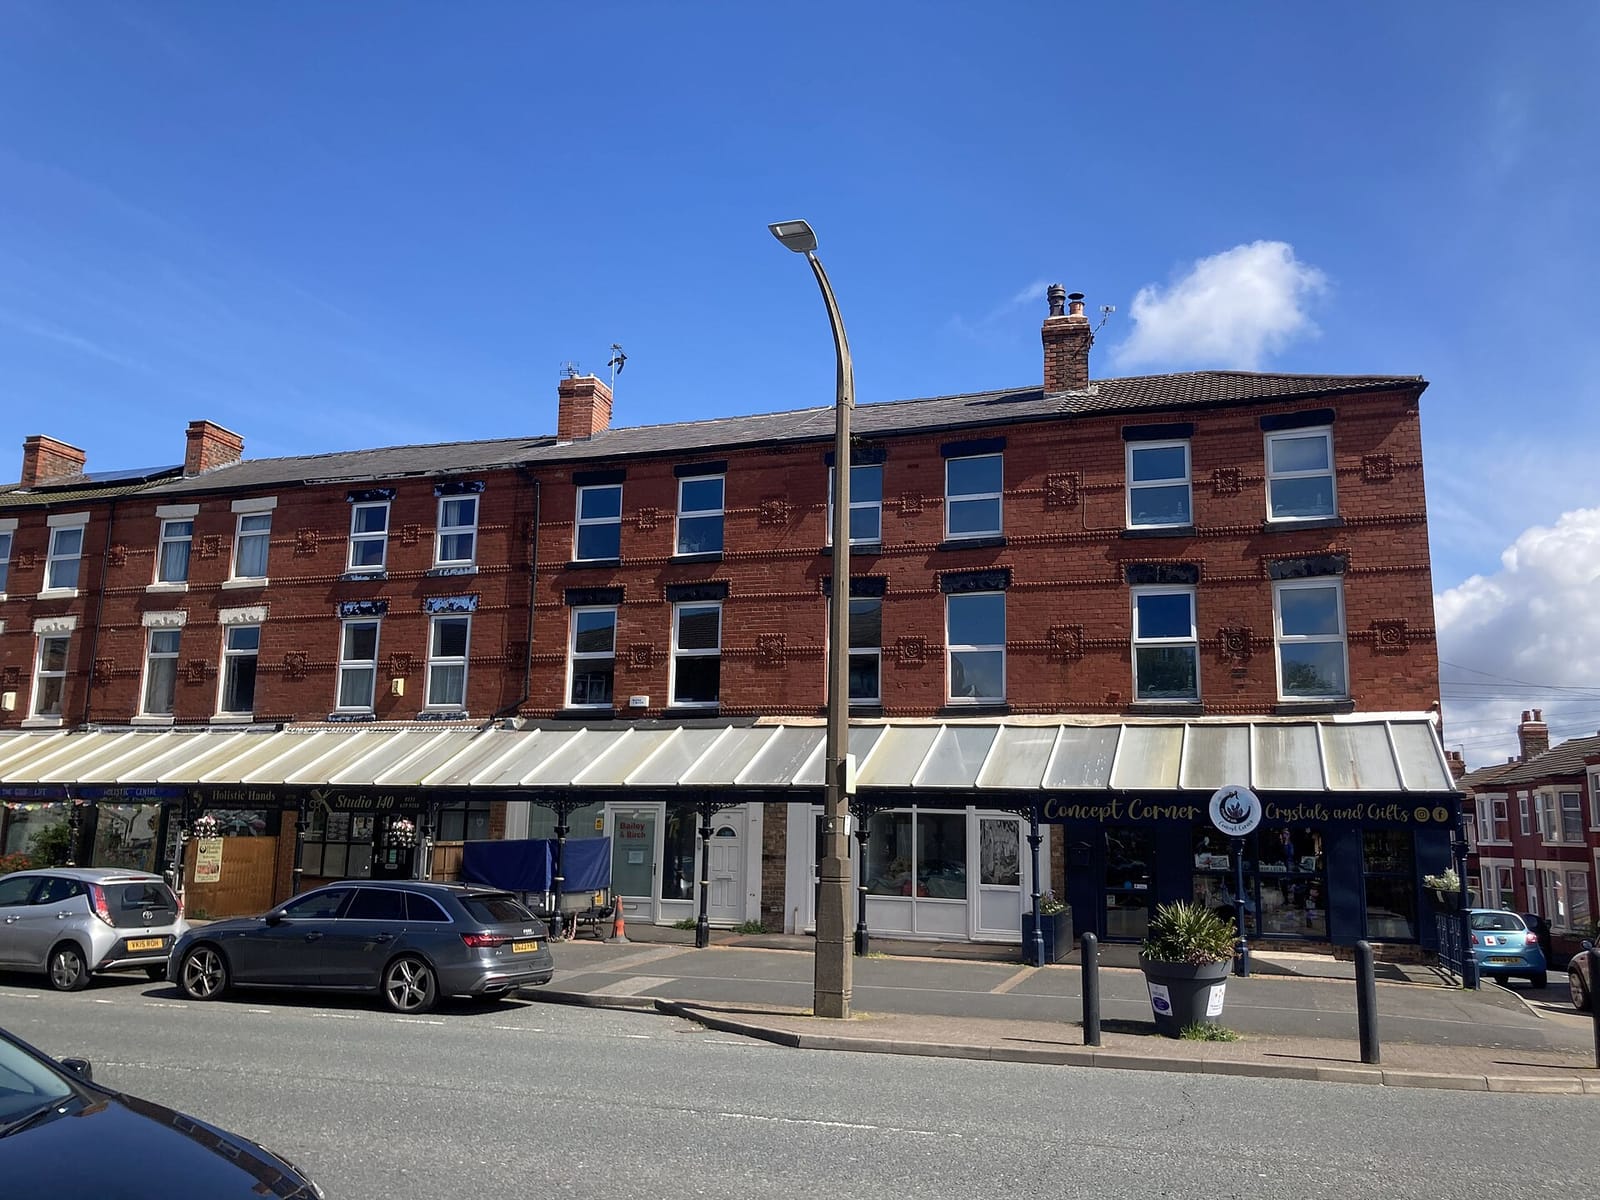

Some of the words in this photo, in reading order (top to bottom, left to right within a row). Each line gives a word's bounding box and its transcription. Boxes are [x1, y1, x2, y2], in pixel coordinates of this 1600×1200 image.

[212, 789, 245, 801] Holistic
[248, 789, 276, 801] Hands
[335, 795, 372, 809] Studio
[376, 795, 394, 809] 140
[1044, 798, 1124, 822] Concept
[1128, 798, 1200, 820] Corner
[1264, 802, 1329, 823] Crystals
[1333, 803, 1364, 820] and
[1367, 803, 1410, 823] Gifts
[620, 822, 645, 830] Bailey
